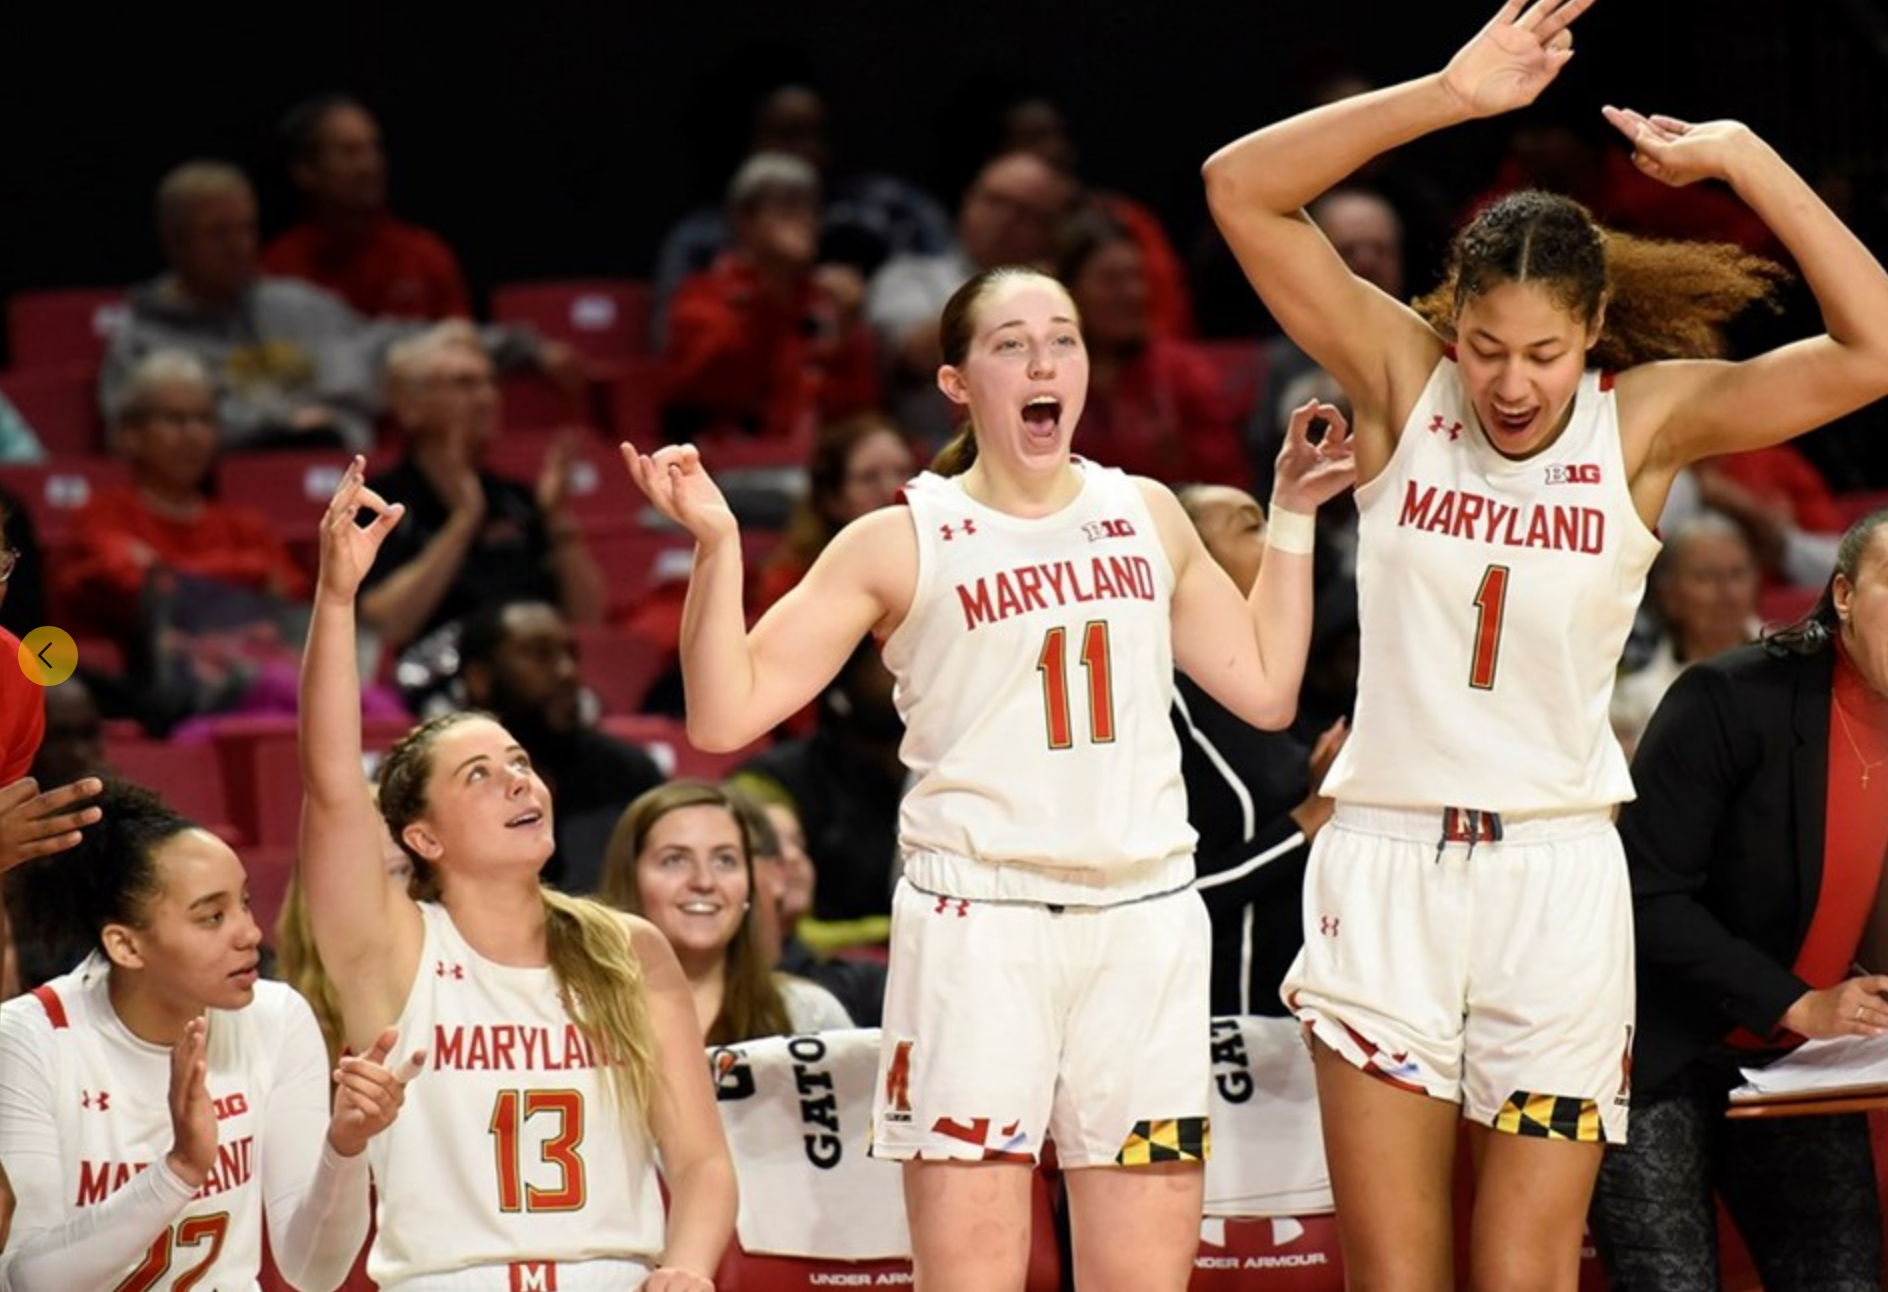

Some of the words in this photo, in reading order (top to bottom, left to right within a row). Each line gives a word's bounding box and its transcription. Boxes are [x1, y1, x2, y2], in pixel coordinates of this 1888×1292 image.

[1398, 480, 1605, 555] MARYLAND
[956, 556, 1155, 631] MARYLAND
[1469, 564, 1510, 690] 1
[1036, 620, 1115, 750] 11
[434, 1024, 626, 1071] MARYLA
[788, 1037, 843, 1170] GATO
[76, 1135, 253, 1208] MAAND
[488, 1089, 587, 1213] 13
[809, 1273, 872, 1286] UNDER
[875, 1273, 914, 1286] ARM
[1193, 1256, 1239, 1269] NDER
[1243, 1252, 1326, 1269] ARMOUR
